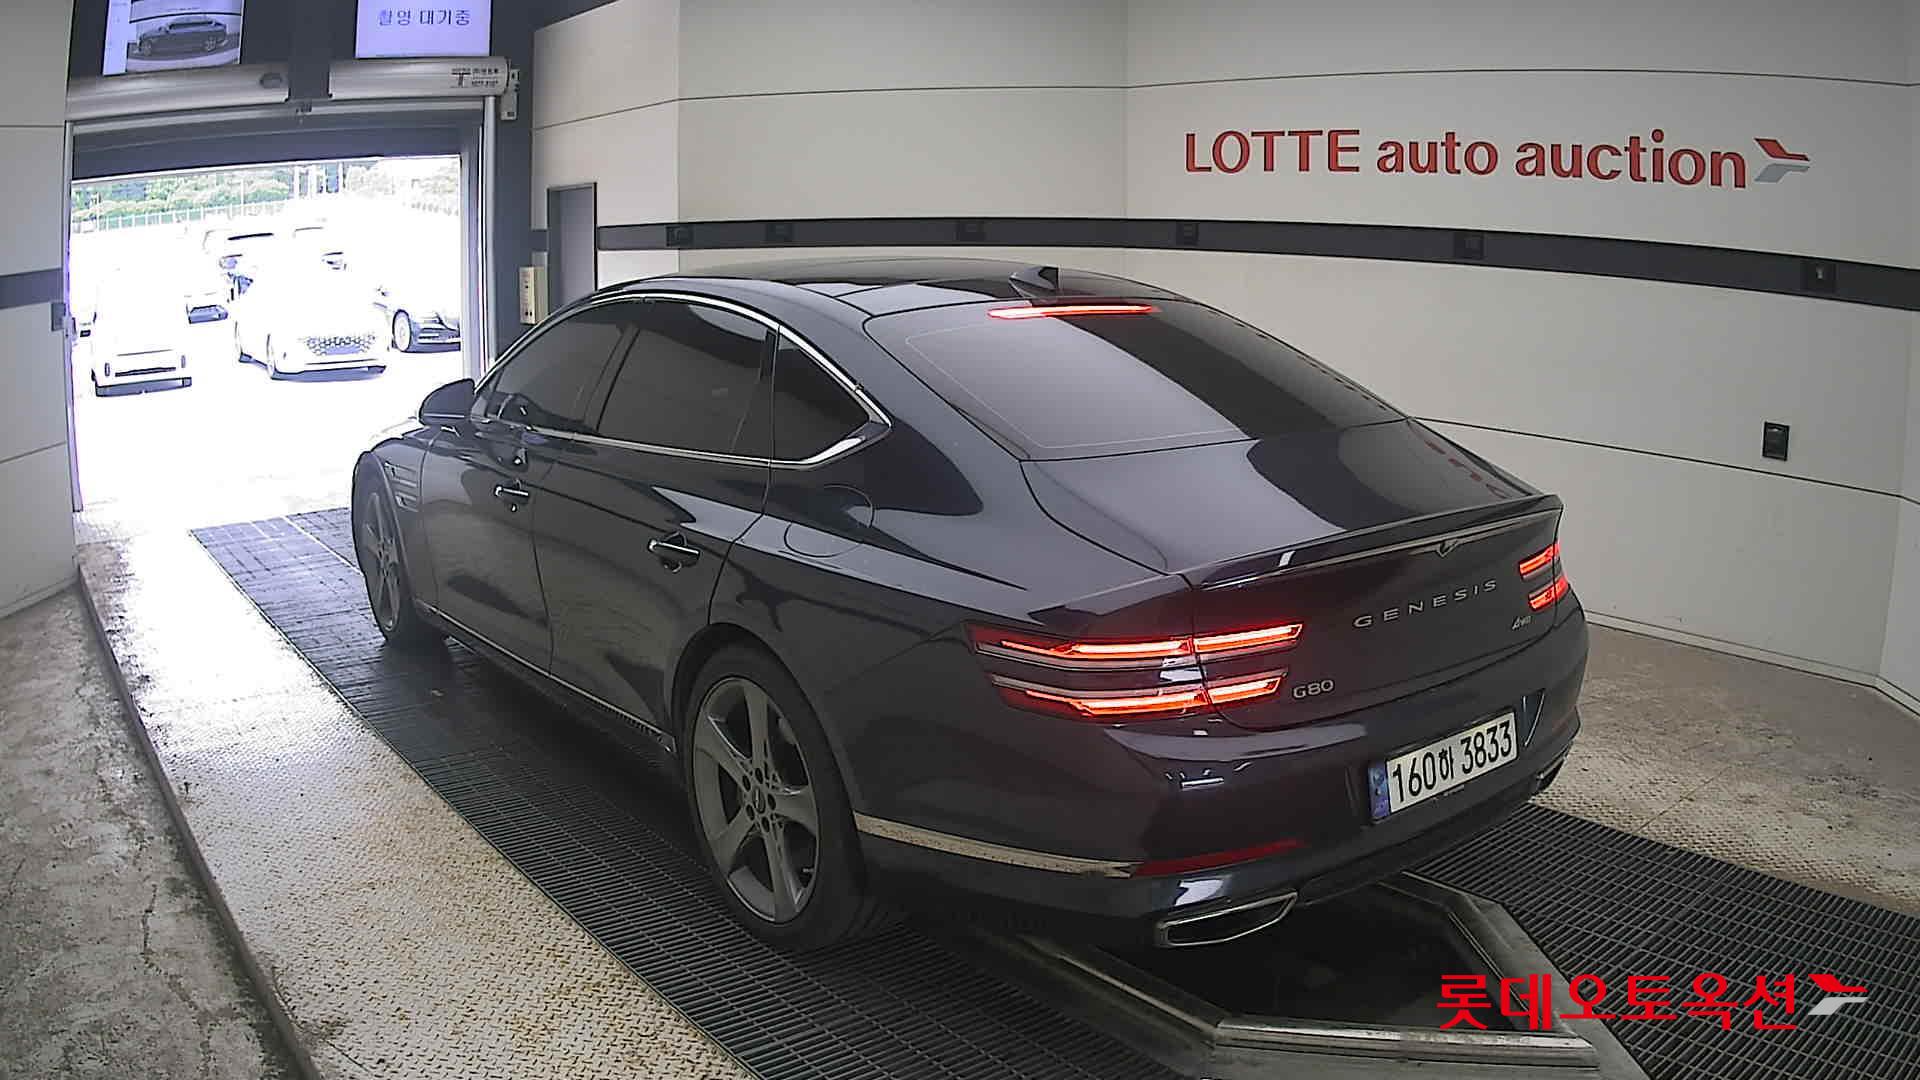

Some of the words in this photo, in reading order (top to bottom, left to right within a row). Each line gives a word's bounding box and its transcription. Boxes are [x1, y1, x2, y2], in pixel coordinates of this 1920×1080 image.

[419, 9, 471, 26] 대기중
[1185, 129, 1360, 174] LOTTE
[1376, 131, 1499, 176] auto
[1514, 128, 1747, 189] auction
[1353, 579, 1497, 628] GENESIS
[1293, 679, 1335, 699] G80
[1392, 746, 1454, 803] 160하
[1460, 720, 1513, 775] 3833
